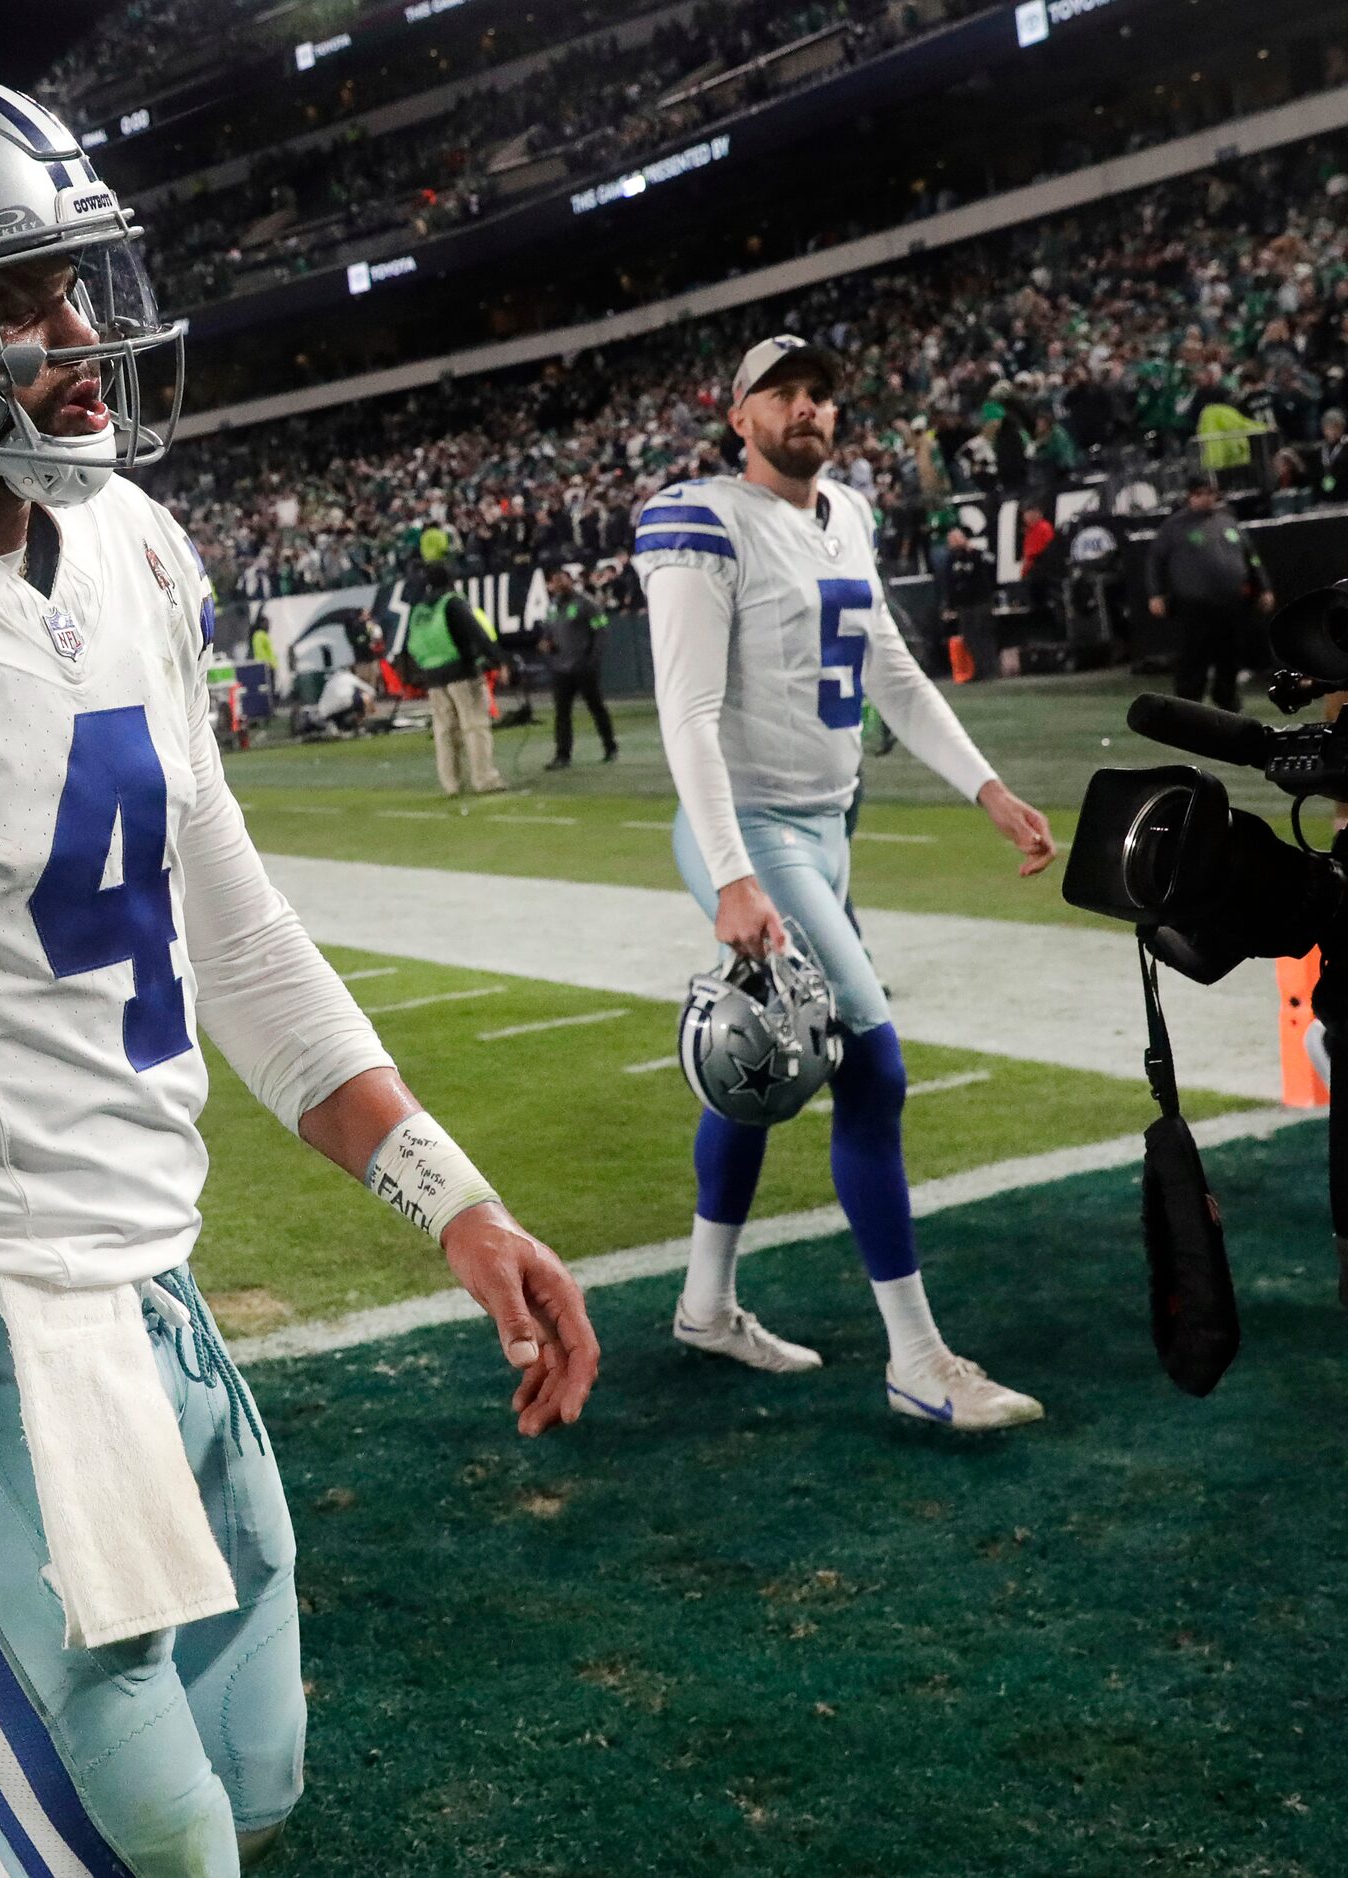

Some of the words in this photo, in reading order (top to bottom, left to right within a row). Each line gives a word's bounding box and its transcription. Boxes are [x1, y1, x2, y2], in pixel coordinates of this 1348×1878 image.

[57, 630, 83, 650] NFL
[817, 578, 873, 730] 5
[28, 704, 194, 1074] 4
[378, 1174, 433, 1234] FAITH
